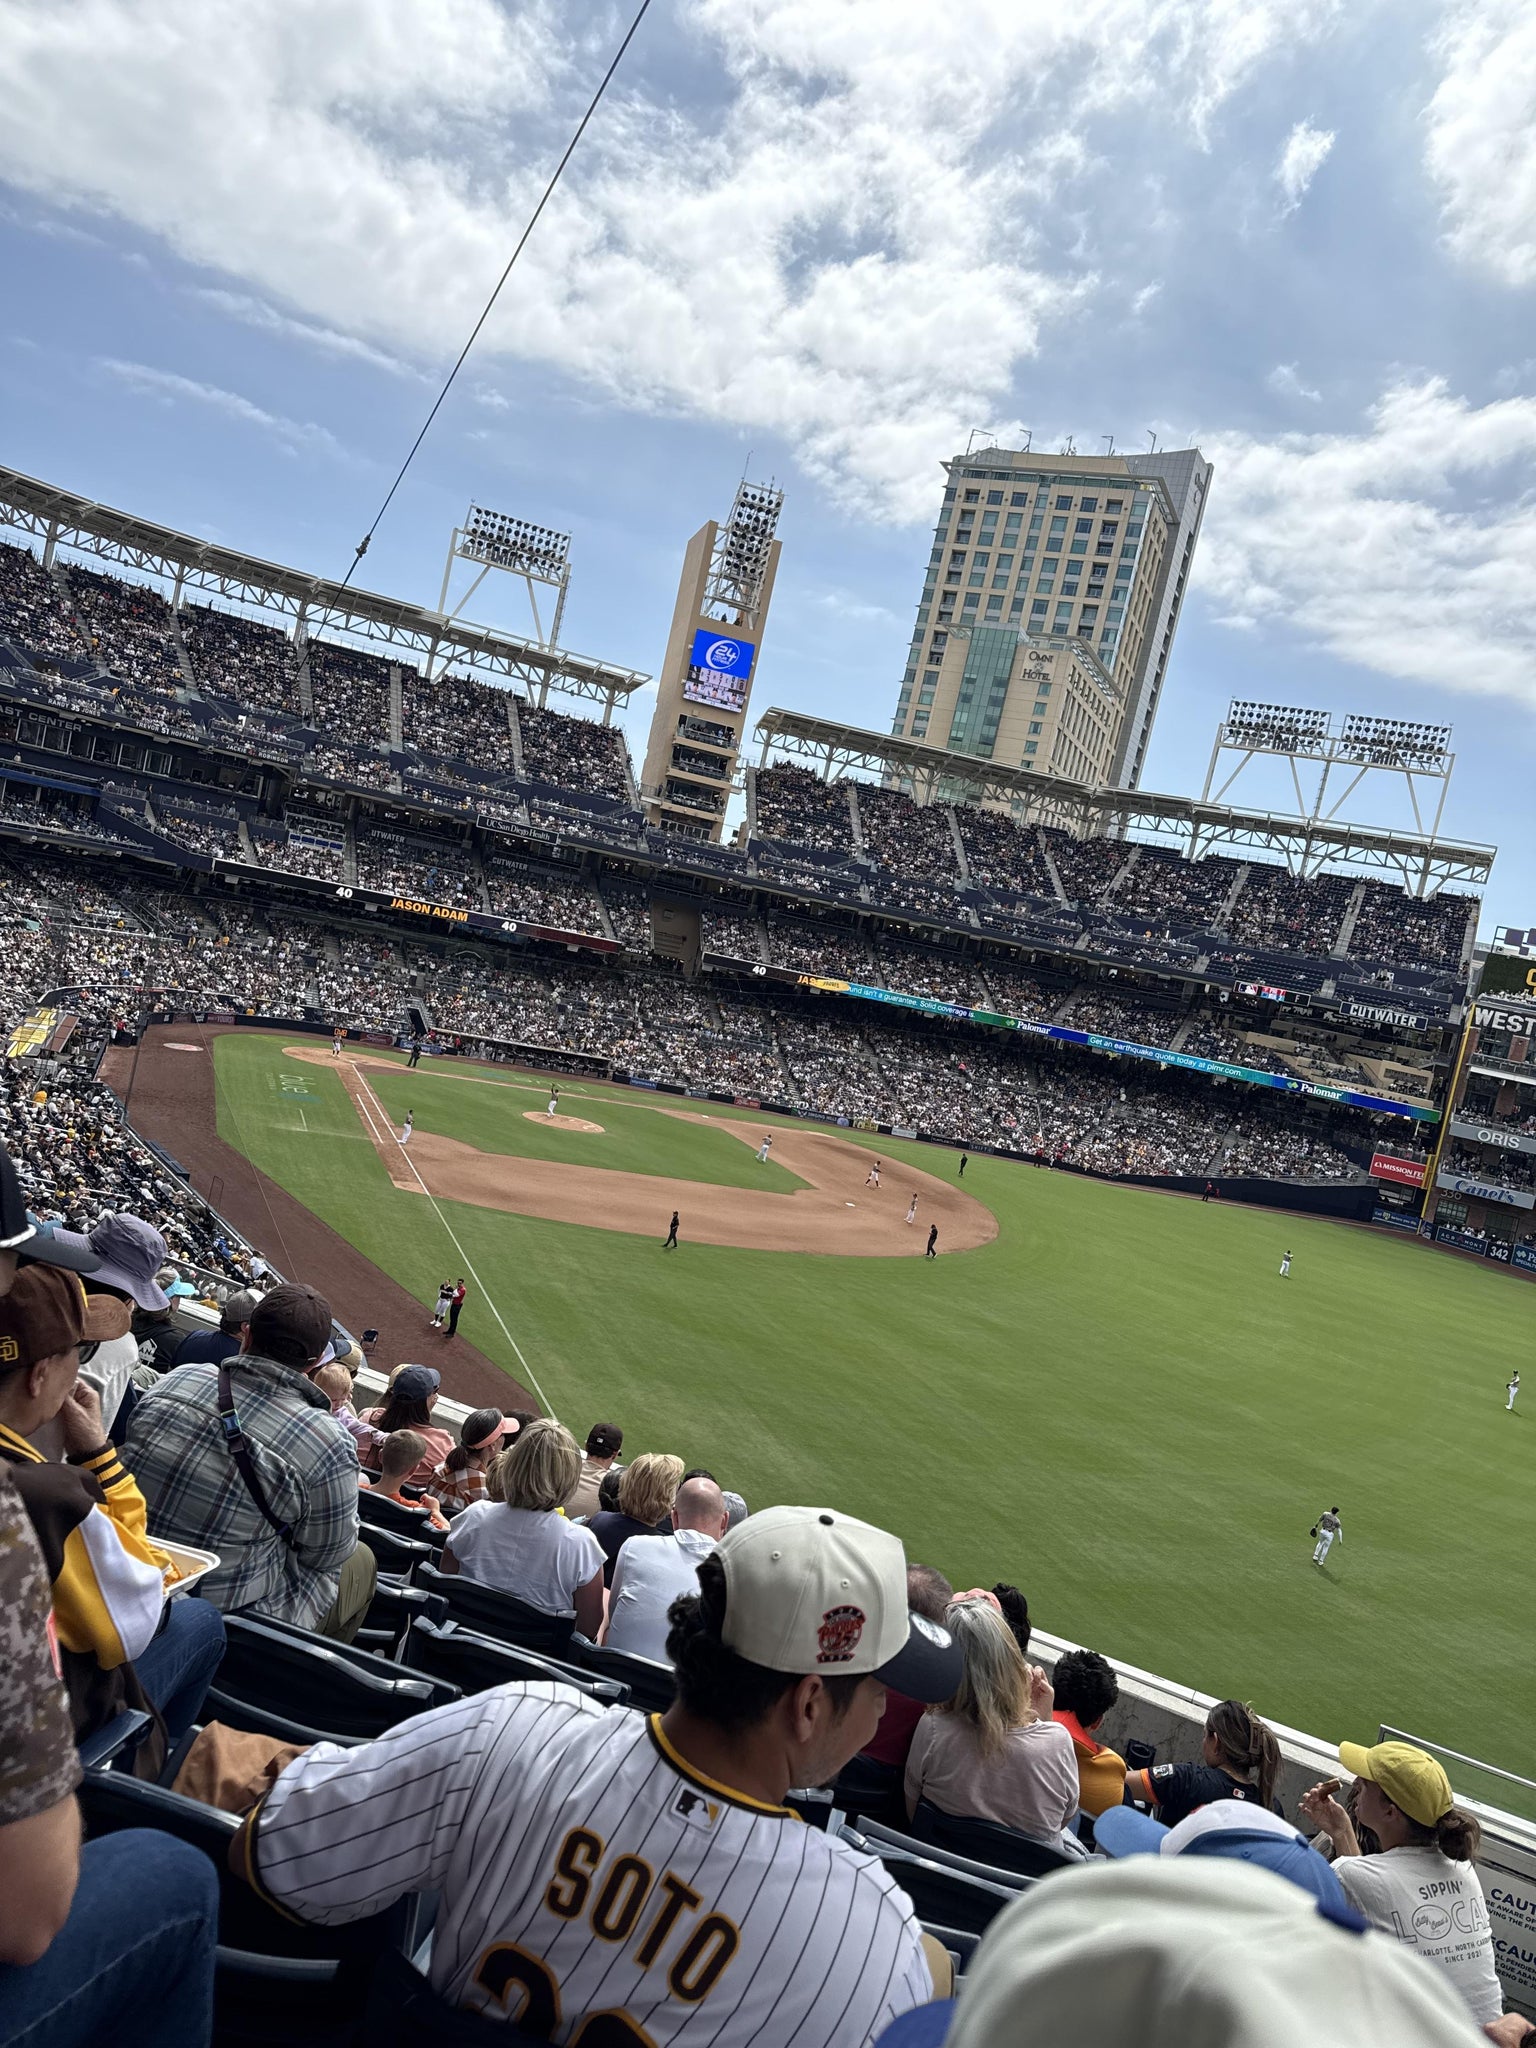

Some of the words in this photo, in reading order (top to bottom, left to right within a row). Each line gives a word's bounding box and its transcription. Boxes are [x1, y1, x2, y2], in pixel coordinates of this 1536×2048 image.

[714, 645, 737, 662] 24
[1029, 651, 1054, 662] OMNI
[1022, 668, 1051, 680] HOTEL
[48, 698, 70, 708] RANDY
[70, 704, 80, 712] 35
[81, 708, 100, 717] JONES
[28, 712, 82, 732] CENTER
[135, 722, 160, 732] TREVOR
[170, 731, 200, 742] HOFFMAN
[226, 744, 246, 754] JACKIE
[258, 752, 288, 764] ROBINSON
[486, 819, 497, 828] UC
[497, 821, 510, 832] San
[510, 824, 530, 836] Diego
[530, 828, 550, 840] Health
[492, 857, 528, 870] CUTWATER
[336, 886, 352, 898] 40
[390, 898, 430, 914] JASON
[432, 907, 468, 922] ADAM
[502, 921, 517, 932] 40
[752, 966, 766, 976] 40
[864, 988, 878, 998] isn't
[884, 993, 918, 1006] guarantee.
[920, 1000, 936, 1010] Solid
[937, 1004, 968, 1016] coverage
[968, 1010, 976, 1018] is.
[1350, 1003, 1417, 1028] CUTWATER
[1016, 1020, 1051, 1034] Palomar
[1090, 1036, 1102, 1045] Get
[1114, 1043, 1153, 1057] earthquake
[1154, 1052, 1176, 1062] quote
[1176, 1056, 1196, 1066] today
[1300, 1083, 1344, 1100] Palomar
[1477, 1130, 1520, 1148] ORIS
[1382, 1164, 1412, 1175] MISSION
[1455, 1180, 1515, 1204] Canel's
[1490, 1246, 1509, 1260] 342
[1418, 1880, 1463, 1900] SIPPIN'
[1486, 1900, 1496, 1908] BE
[1496, 1904, 1524, 1920] AWARE
[1490, 1888, 1536, 1916] CAUT
[544, 1827, 741, 2002] SOTO
[1508, 1916, 1524, 1926] THE
[1454, 1942, 1475, 1952] NORTH
[1444, 1954, 1464, 1964] SINCE
[1467, 1950, 1482, 1960] 2021
[1500, 1962, 1516, 1972] QUE
[1518, 1978, 1528, 1986] DE
